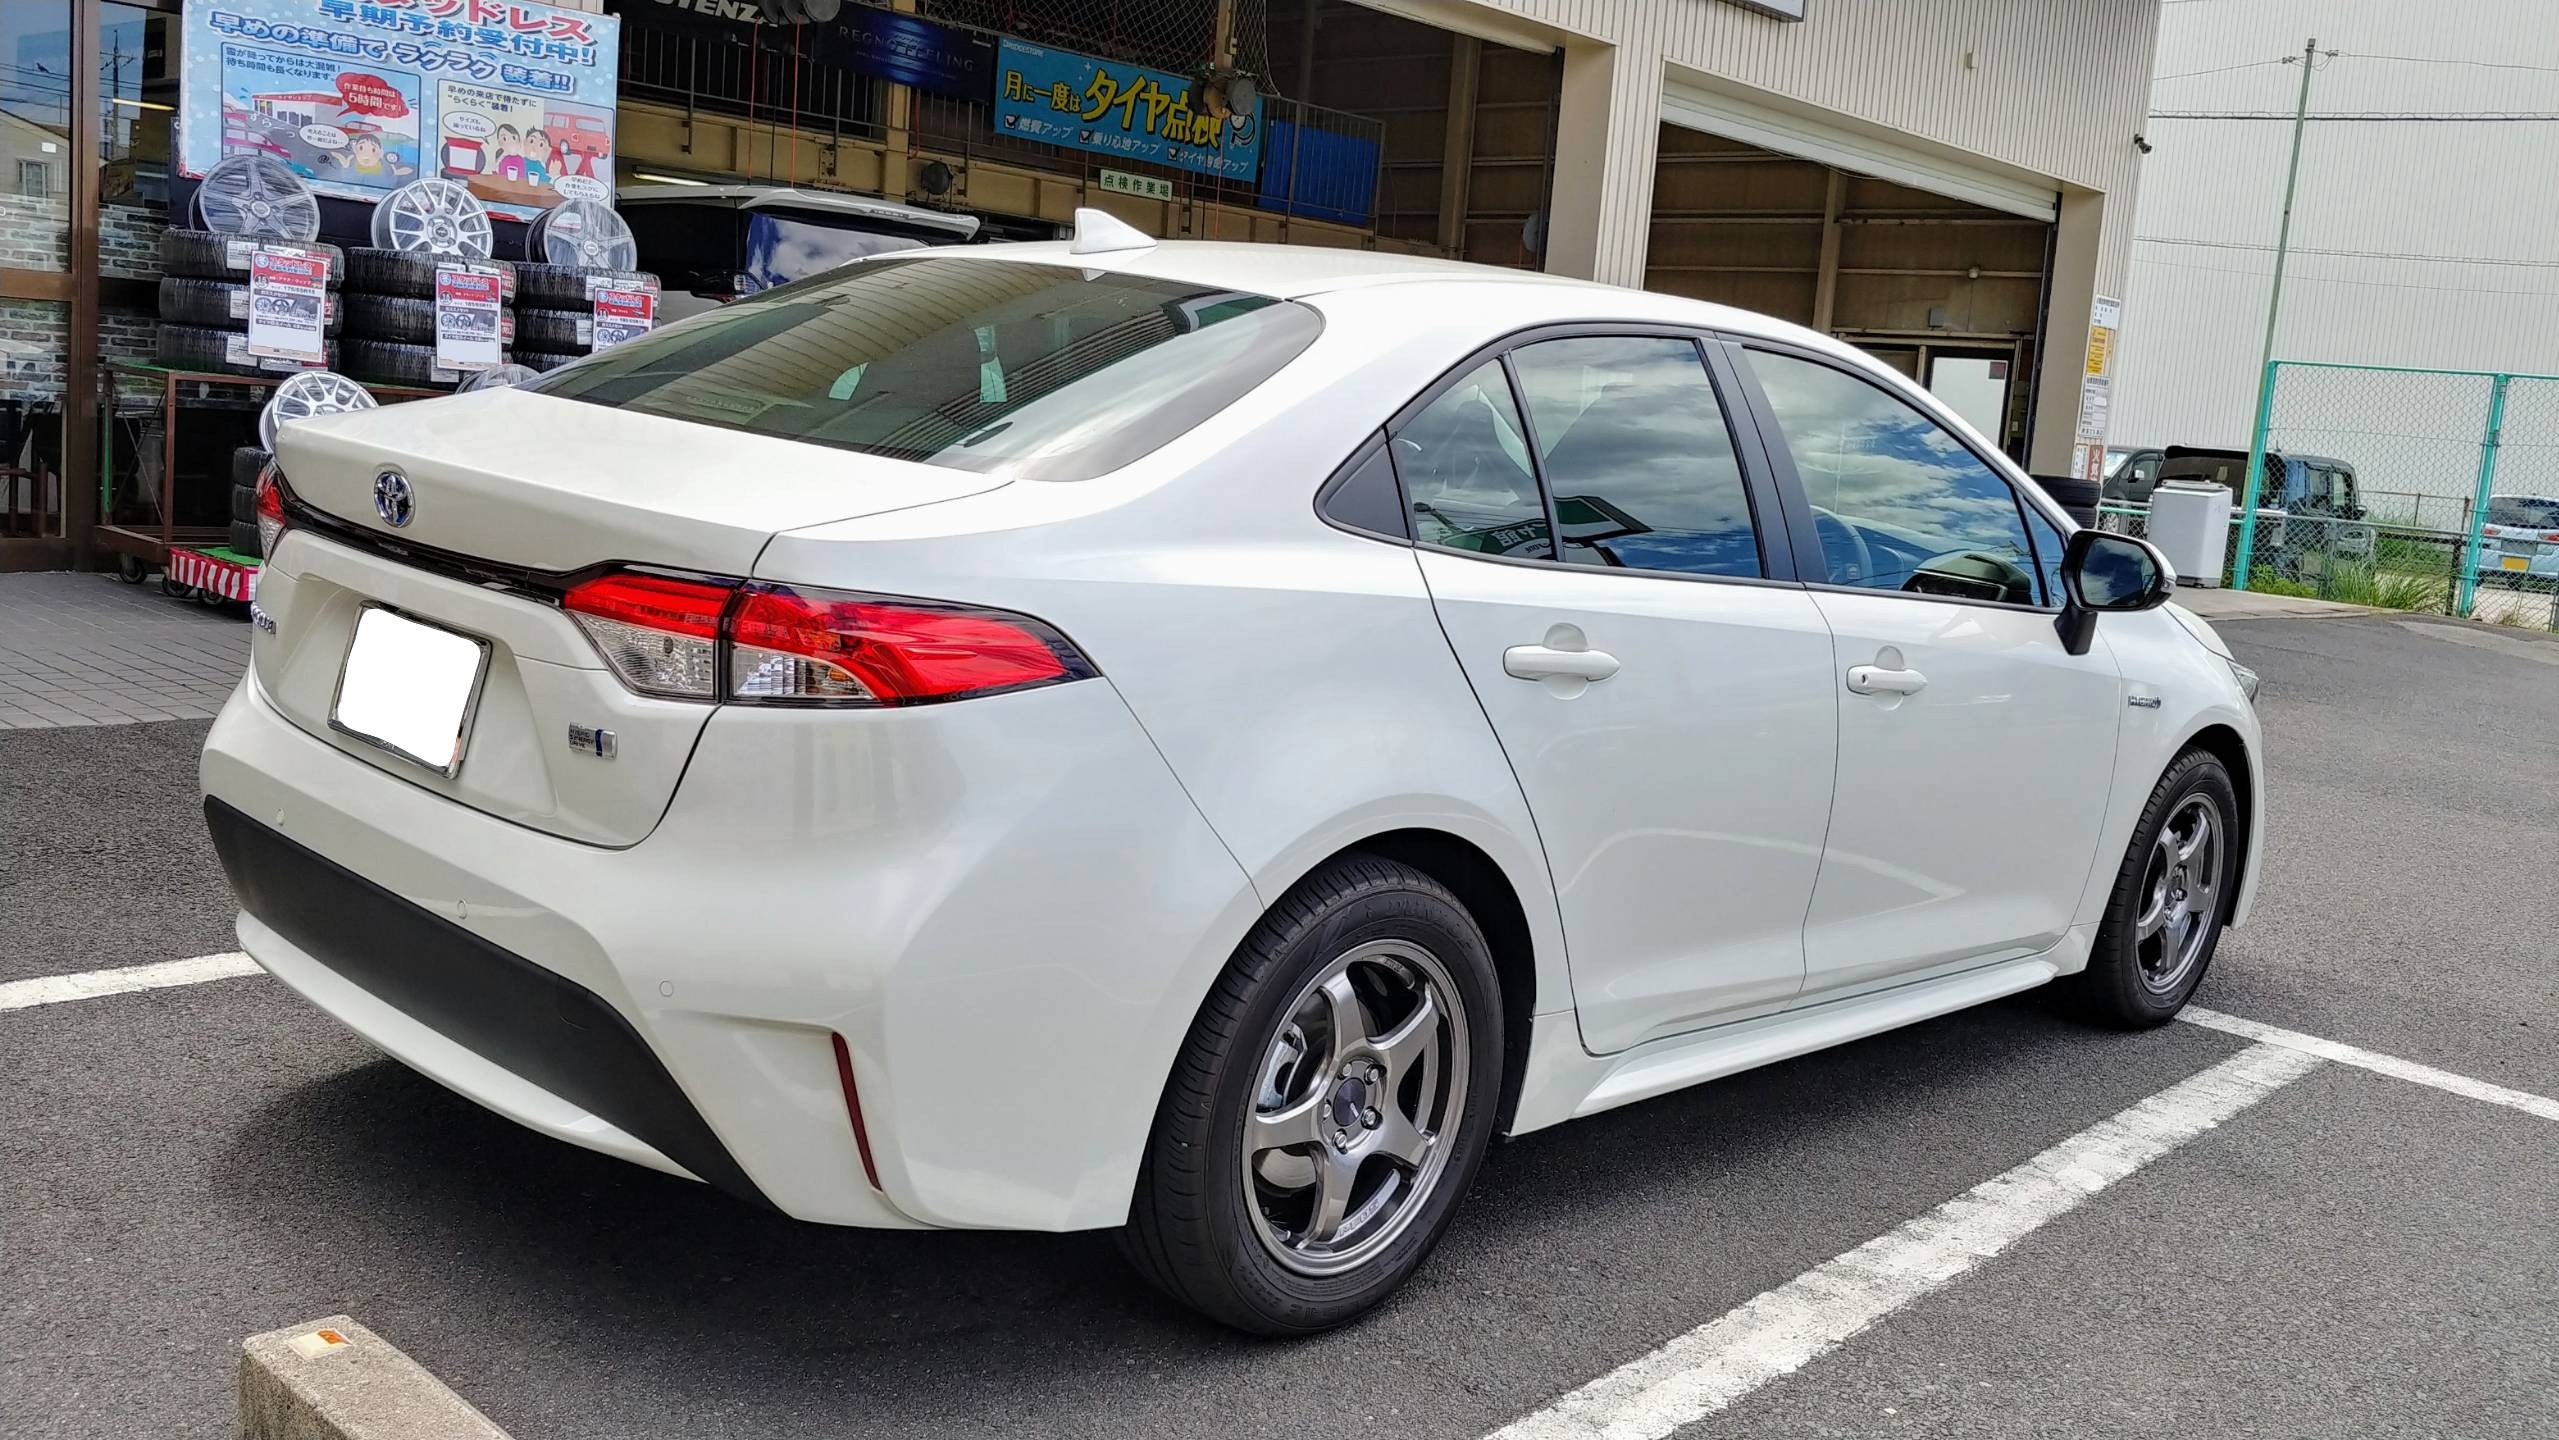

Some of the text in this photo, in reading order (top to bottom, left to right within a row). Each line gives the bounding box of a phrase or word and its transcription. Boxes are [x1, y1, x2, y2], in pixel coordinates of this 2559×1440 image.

[379, 0, 592, 43] ッドレス
[838, 26, 897, 51] REGNO
[1103, 174, 1170, 198] 点検作業場
